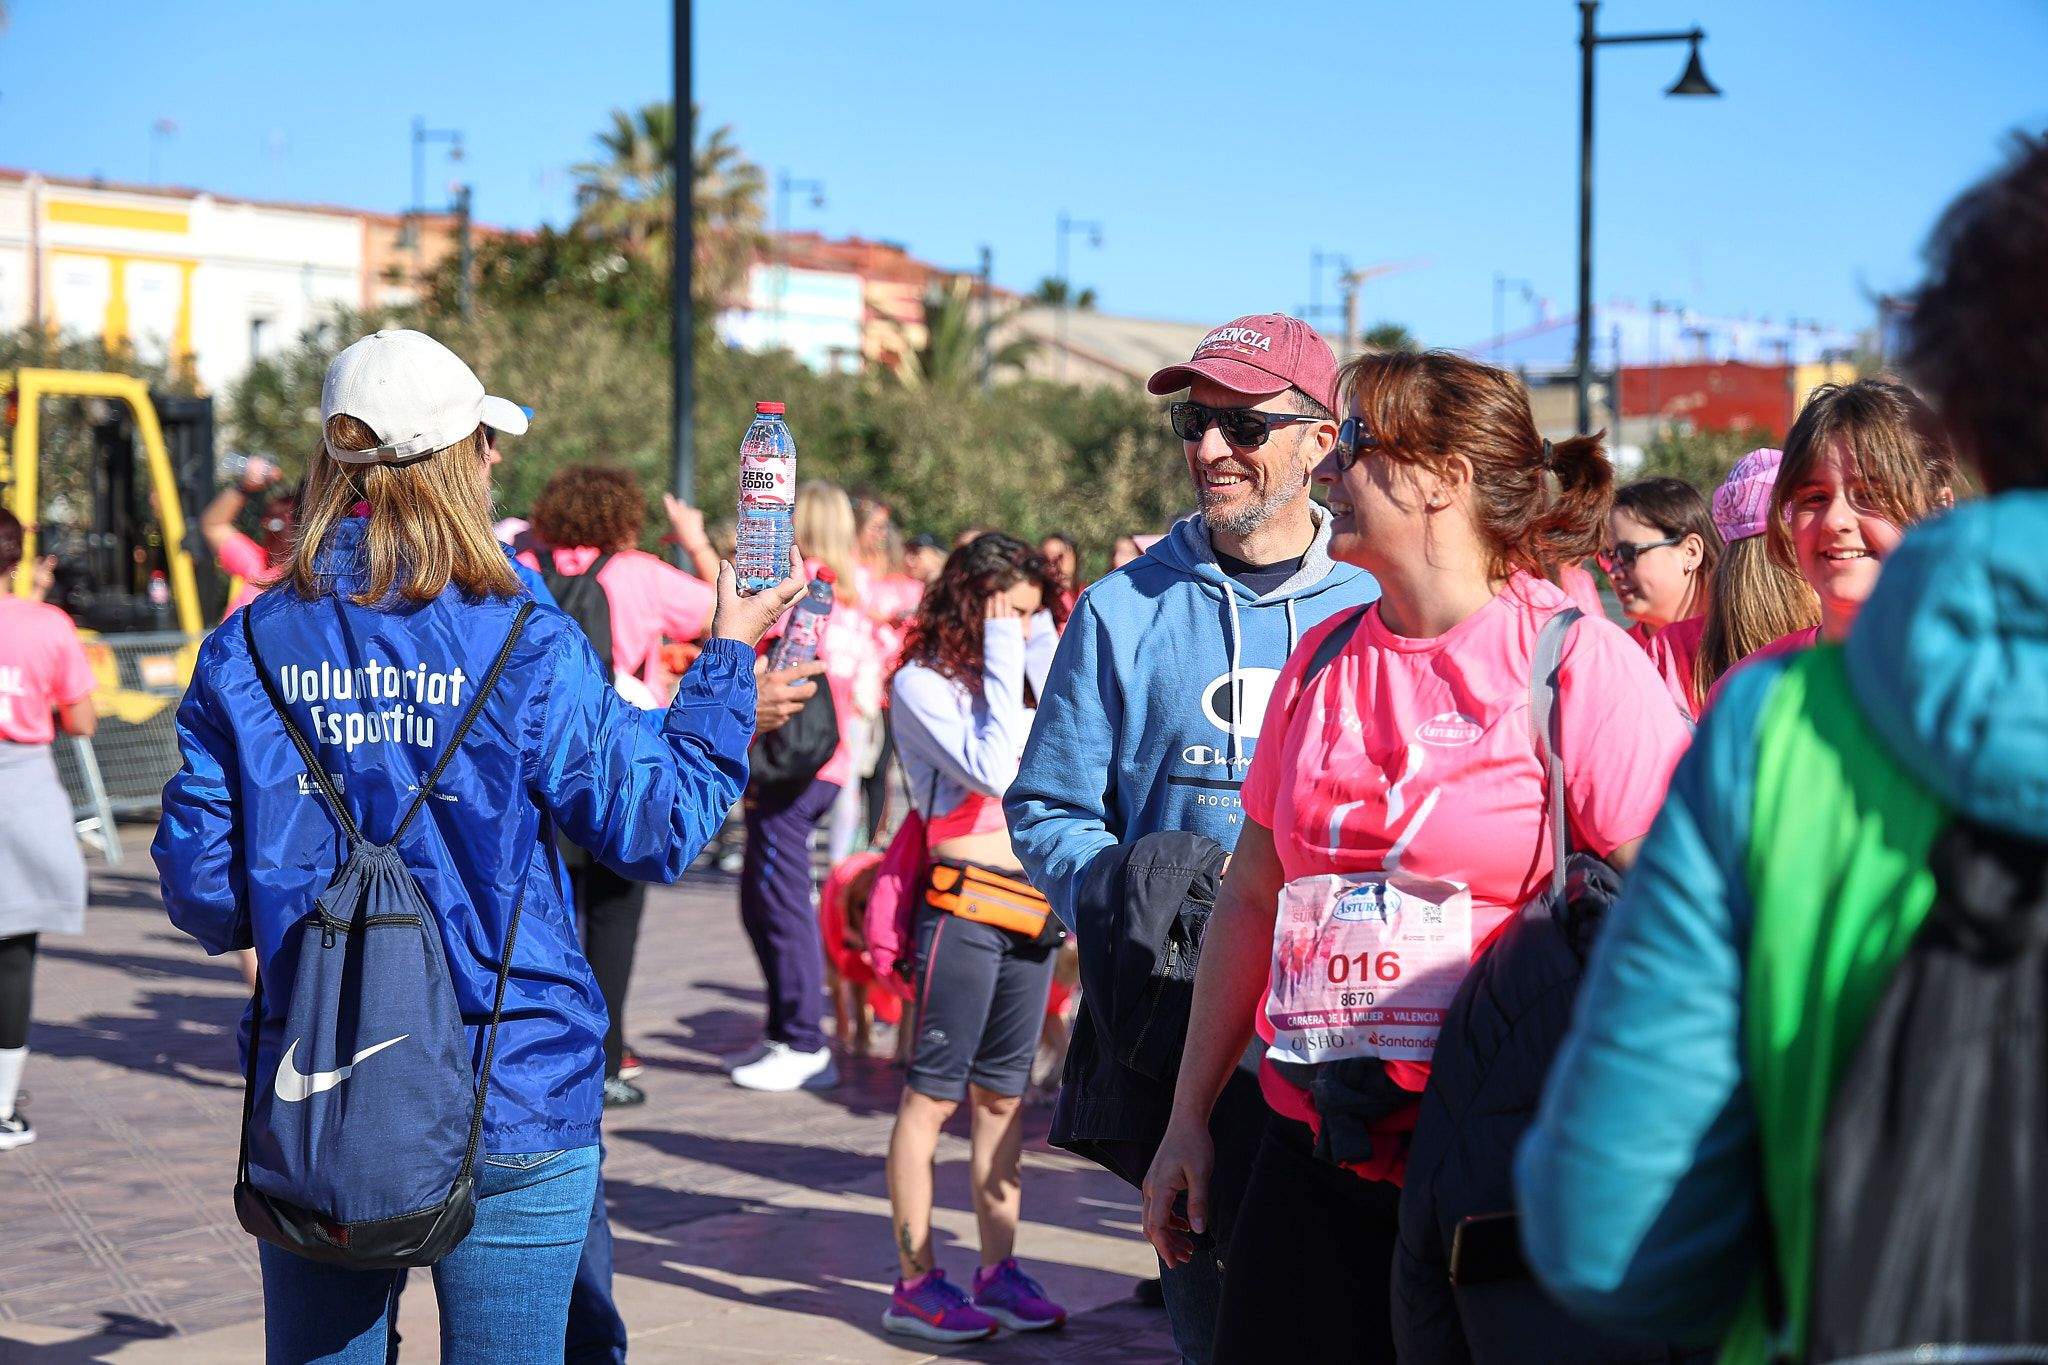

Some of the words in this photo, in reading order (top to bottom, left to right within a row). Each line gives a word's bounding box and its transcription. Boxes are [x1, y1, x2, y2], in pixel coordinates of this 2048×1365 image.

[742, 470, 774, 481] ZERO
[741, 480, 774, 489] SODIO
[280, 658, 466, 707] Voluntariat
[310, 704, 434, 753] Esportiu
[1327, 951, 1401, 984] 016
[1341, 992, 1375, 1007] 8670
[1287, 1014, 1325, 1027] CARRERA
[1352, 1011, 1384, 1023] MUJER
[1392, 1011, 1440, 1023] VALENCIA
[1379, 1035, 1438, 1048] Santande
